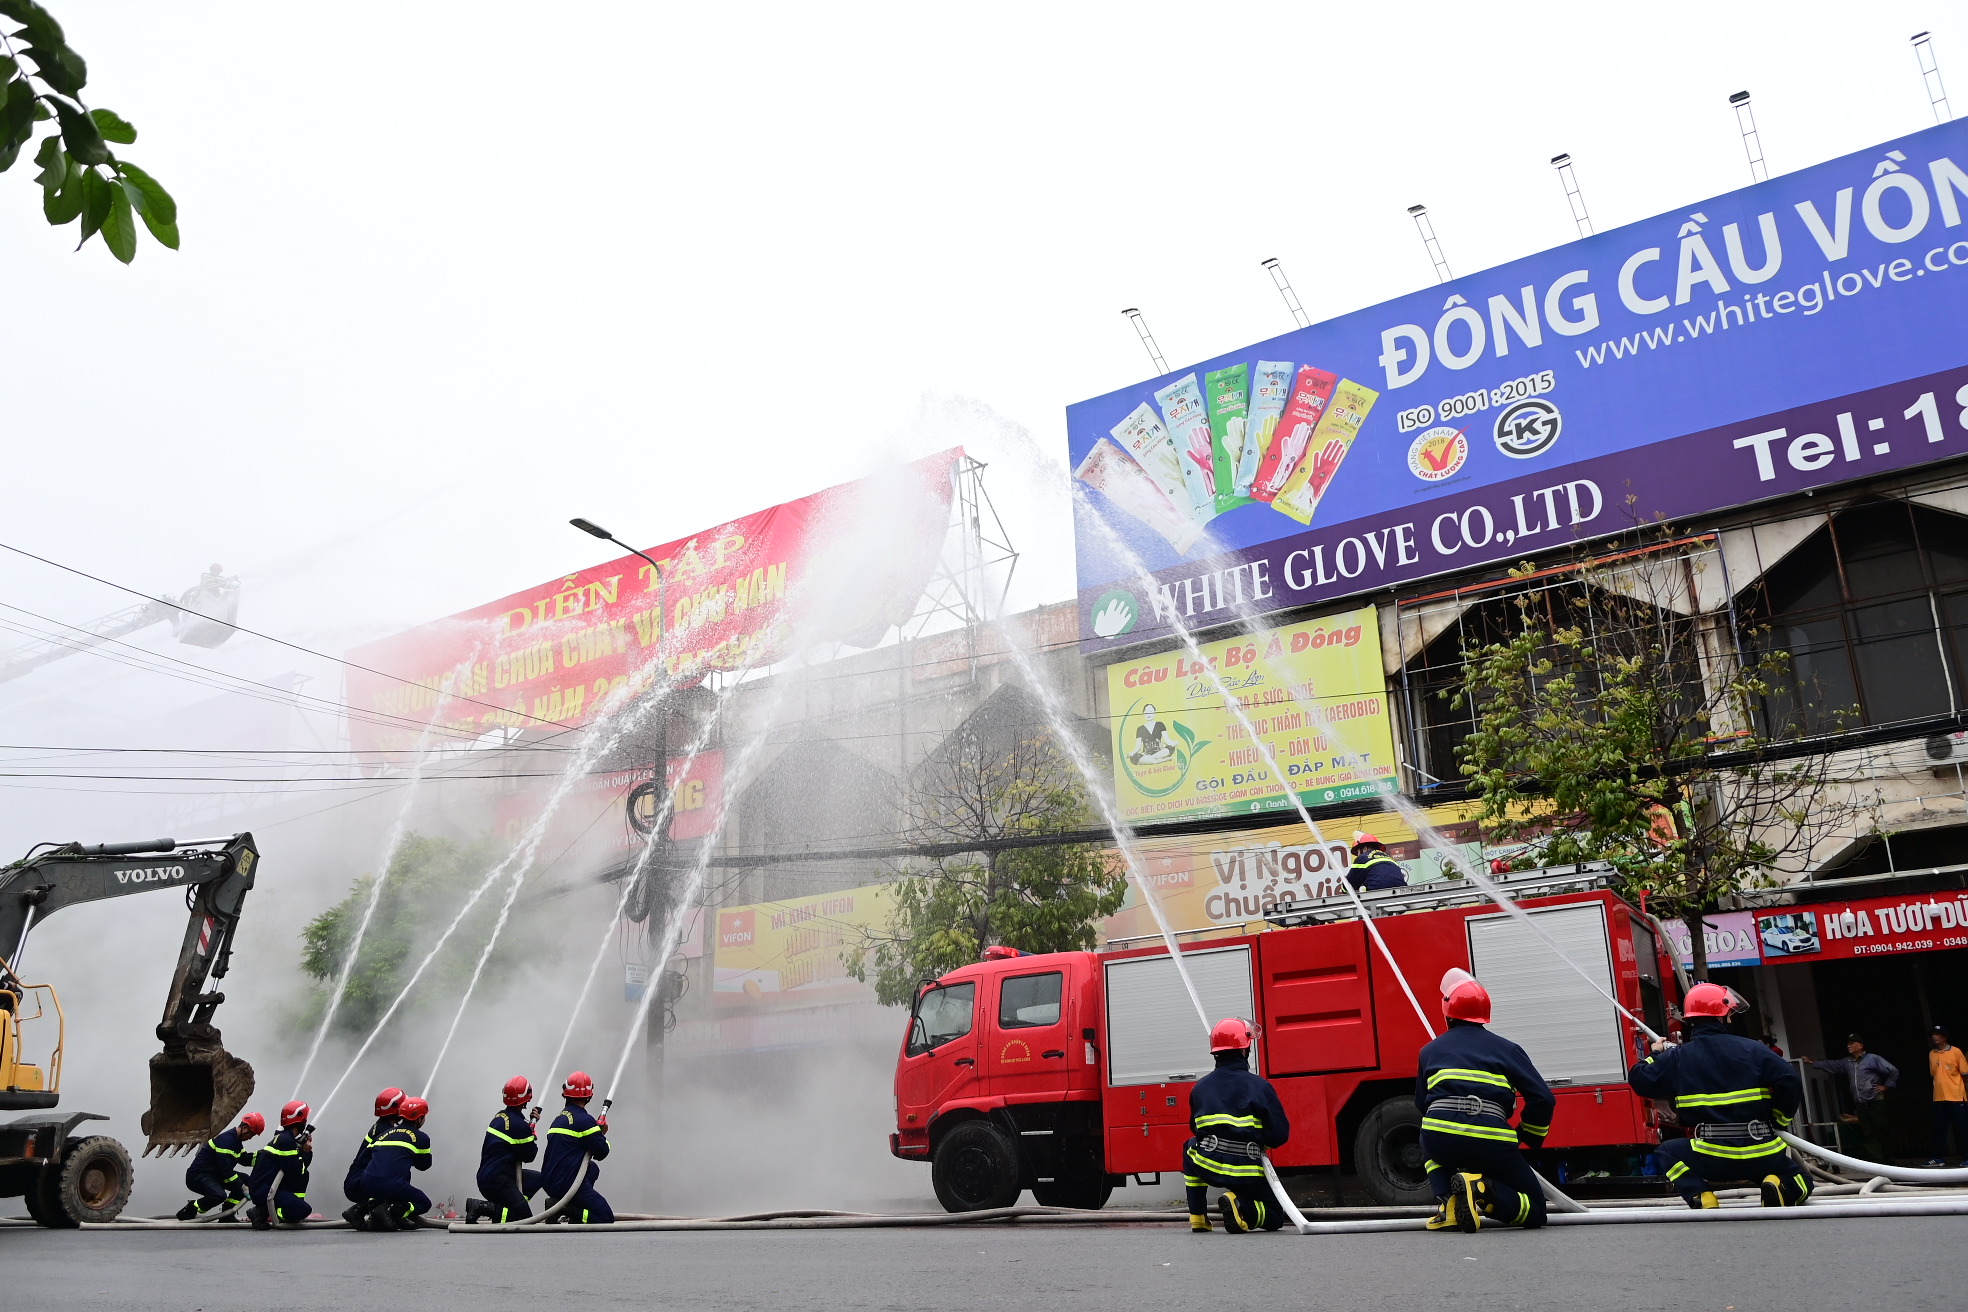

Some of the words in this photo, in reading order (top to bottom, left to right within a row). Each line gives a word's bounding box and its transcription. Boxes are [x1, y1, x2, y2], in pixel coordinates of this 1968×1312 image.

[1378, 270, 1600, 390] ĐÔNG
[1617, 212, 1783, 315] CẦU
[1575, 241, 1968, 369] www.whiteglove.co
[1399, 407, 1433, 431] ISO
[1428, 438, 1445, 448] 2018
[1732, 411, 1890, 482] Tel:
[1903, 383, 1968, 444] 1
[1457, 439, 1466, 454] CAO
[1146, 559, 1273, 624] WHITE
[1283, 522, 1420, 591] GLOVE
[1430, 478, 1603, 556] CO.,LTD
[500, 574, 624, 638] DIỄN
[638, 534, 745, 593] TẬP
[1123, 666, 1168, 688] Câu
[1175, 656, 1218, 681] Lạc
[1225, 643, 1257, 670] Bộ
[1263, 631, 1284, 660] Á
[1289, 625, 1362, 654] Đông
[1224, 693, 1251, 714] YGA
[1325, 698, 1381, 723] (AEROBIC)
[1289, 737, 1310, 757] DÂN
[1195, 777, 1225, 792] GỘI
[1231, 768, 1268, 785] ĐẦU
[1287, 758, 1324, 776] ĐẮP
[114, 866, 185, 884] VOLVO
[1148, 871, 1189, 886] VIFON
[1213, 851, 1246, 890] Vị
[1256, 846, 1349, 885] Ngon
[822, 897, 855, 915] VIFON
[1823, 910, 1875, 940] HOA
[1875, 902, 1934, 935] TƯƠI
[723, 932, 752, 944] VIFON
[1704, 929, 1755, 954] HOA
